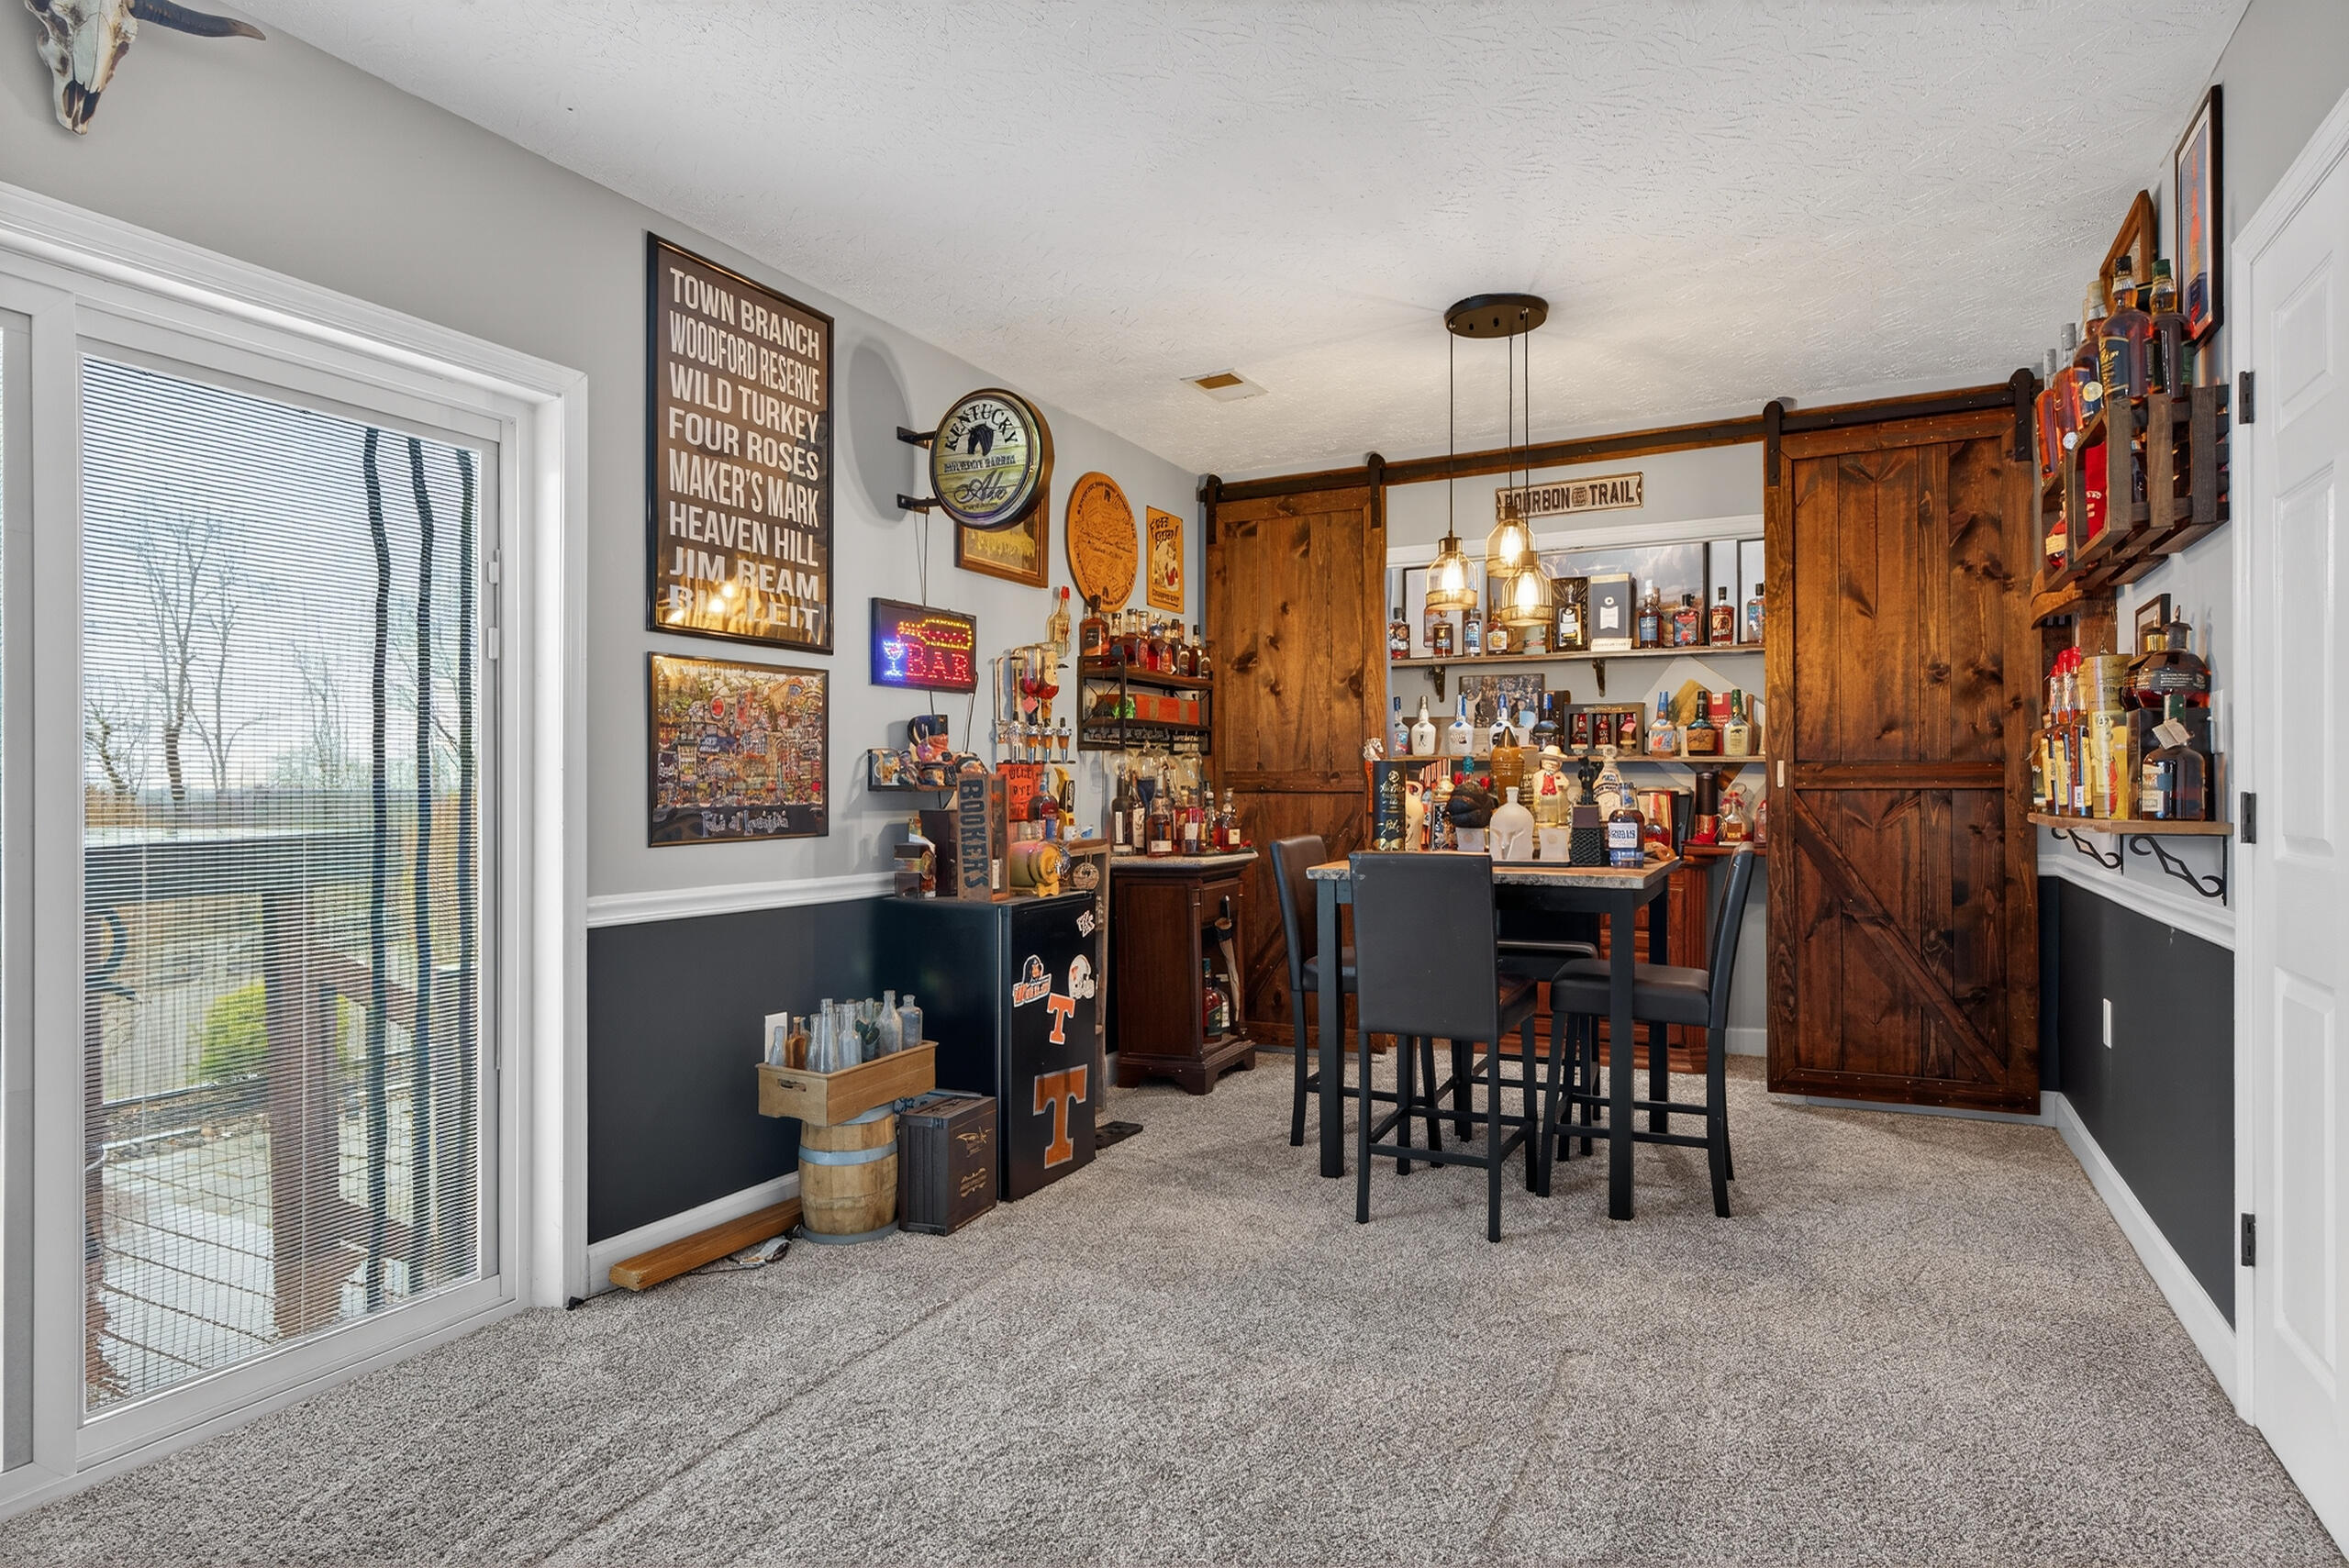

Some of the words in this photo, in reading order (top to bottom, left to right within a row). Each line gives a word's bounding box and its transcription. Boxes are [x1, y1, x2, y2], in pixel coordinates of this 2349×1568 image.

[670, 267, 735, 325] TOWN
[740, 298, 819, 361] BRANCH
[670, 310, 757, 381] WOODFORD
[760, 346, 819, 406] RESERVE
[670, 361, 732, 414] WILD
[738, 384, 818, 443] TURKEY
[944, 403, 1019, 451] KENTUCKY
[669, 406, 740, 457] FOUR
[747, 430, 818, 481] ROSES
[669, 448, 763, 513] MAKER'S
[768, 475, 818, 528] MARK
[1588, 481, 1635, 506] TRAIL
[670, 500, 767, 555] HEAVEN
[774, 526, 818, 567] HILL
[669, 546, 726, 583] JIM
[737, 559, 818, 602] BEAM
[669, 584, 818, 631] BLEIT
[905, 642, 972, 682] BAR
[1033, 1064, 1087, 1169] T
